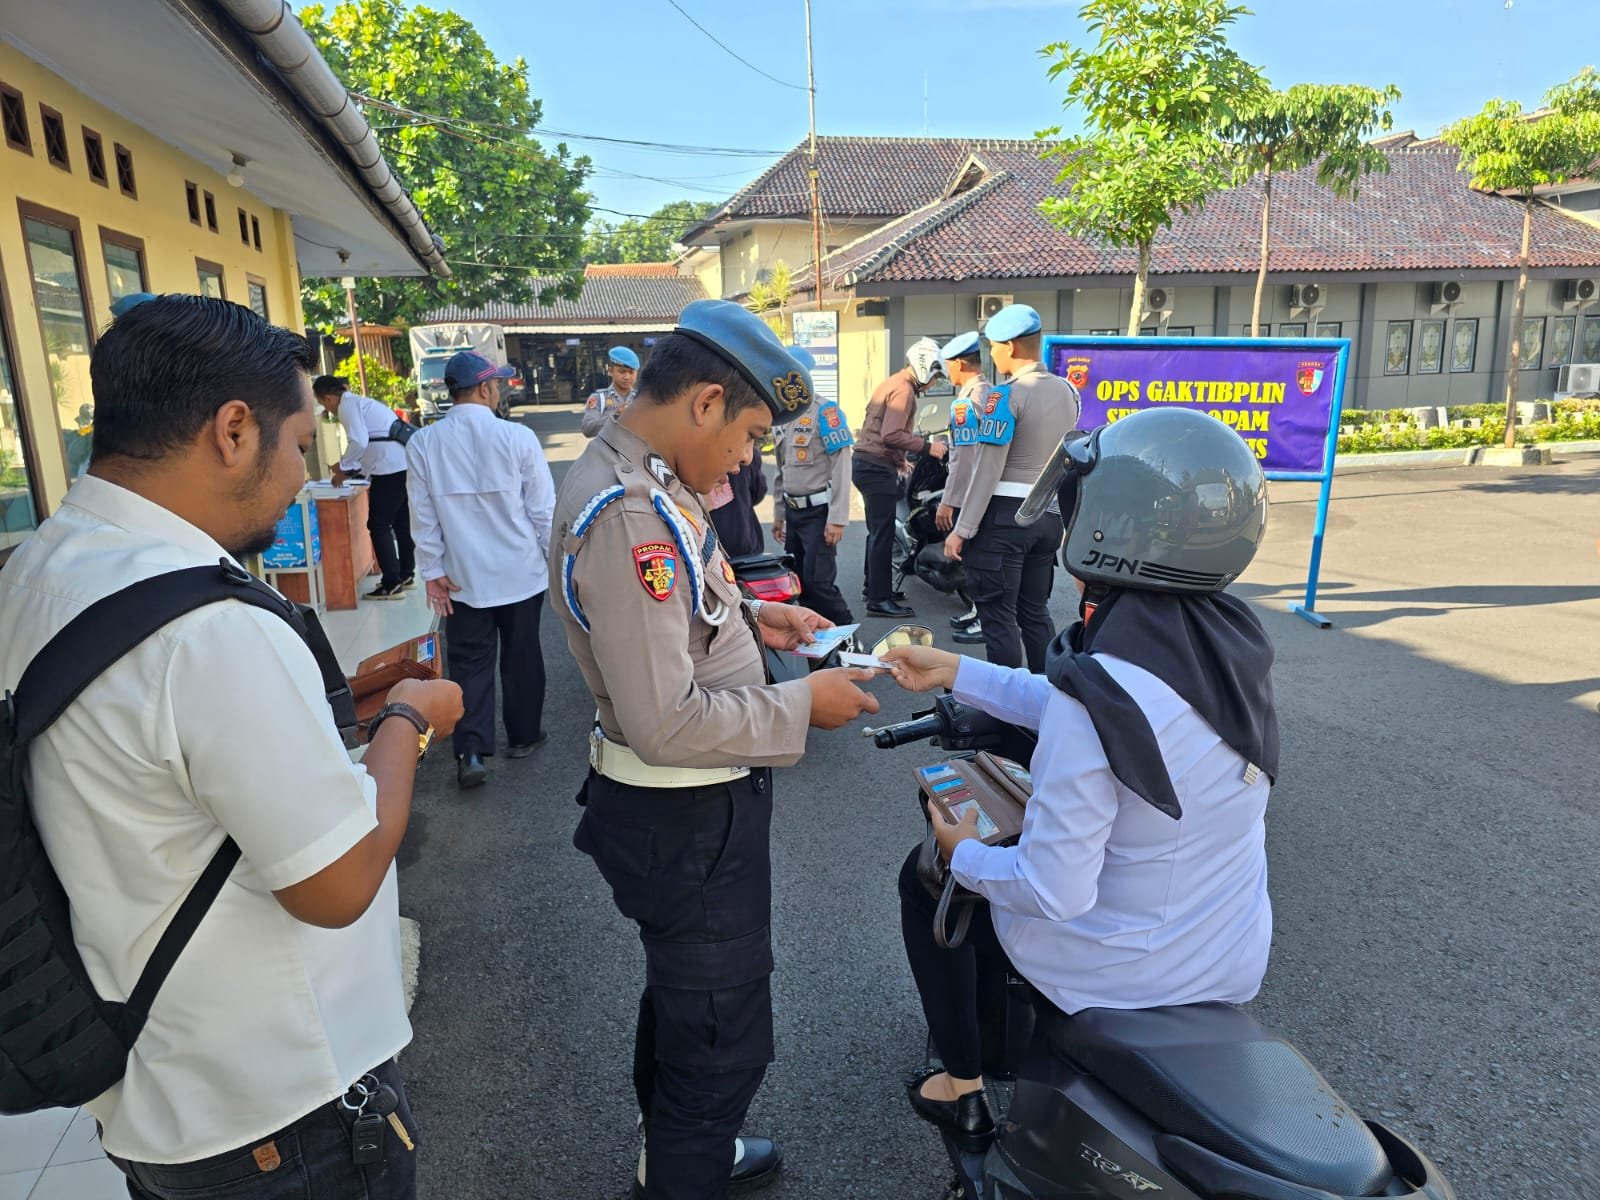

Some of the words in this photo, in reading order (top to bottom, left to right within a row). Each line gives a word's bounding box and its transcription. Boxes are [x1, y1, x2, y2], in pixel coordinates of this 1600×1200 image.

[1096, 381, 1140, 402] OPS
[1146, 381, 1286, 404] GAKTIBPLIN
[636, 544, 673, 555] PROPAM
[1081, 550, 1140, 575] JPN
